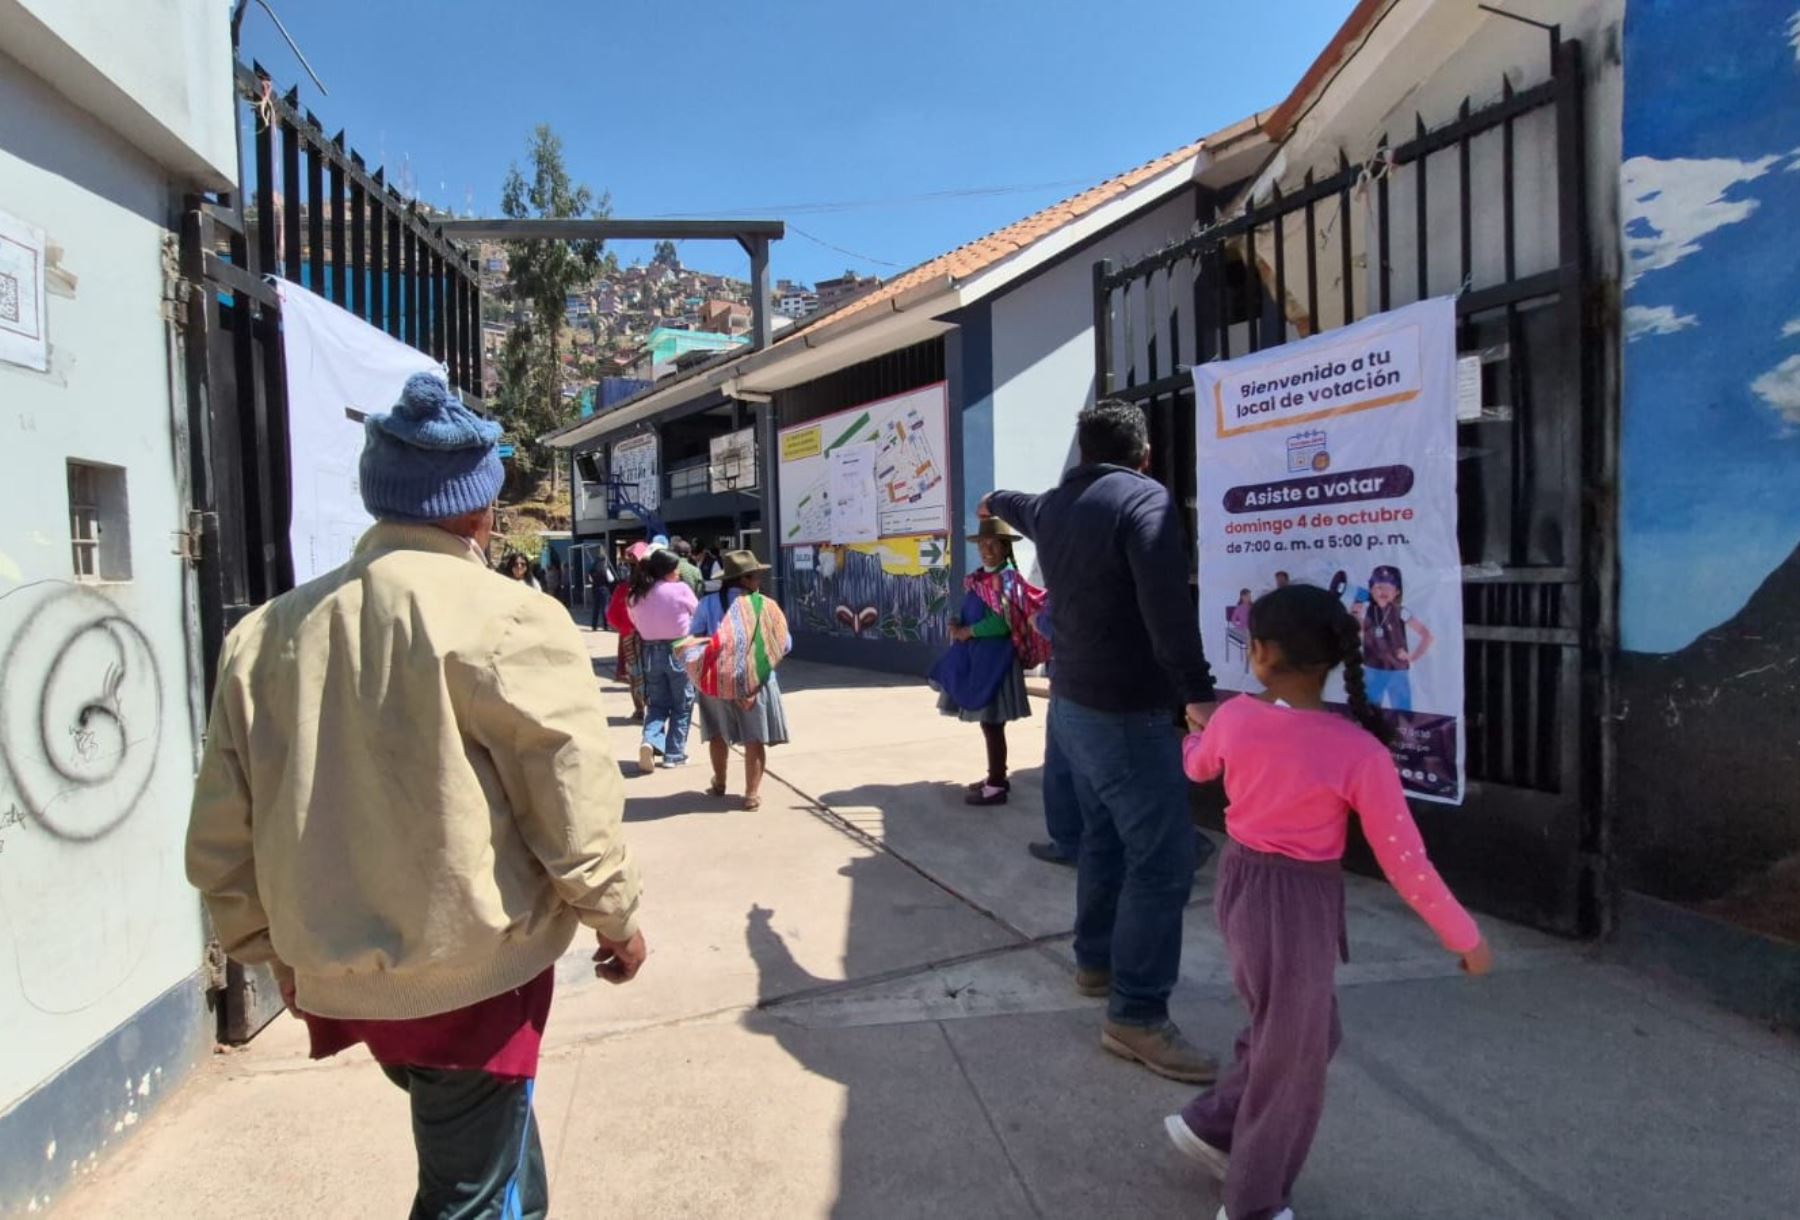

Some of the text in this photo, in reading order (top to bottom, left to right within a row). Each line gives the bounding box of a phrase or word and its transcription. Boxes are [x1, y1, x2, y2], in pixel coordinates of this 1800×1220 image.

[1240, 350, 1391, 398] Bienvenido a tu
[1236, 369, 1400, 419] local de votación
[1244, 476, 1384, 507] Asiste a votar
[1225, 506, 1414, 535] domingo 4 de octubre
[1226, 542, 1242, 554] de
[1244, 540, 1271, 553] 7:00
[1313, 537, 1325, 549] a
[1328, 533, 1362, 549] 5:00
